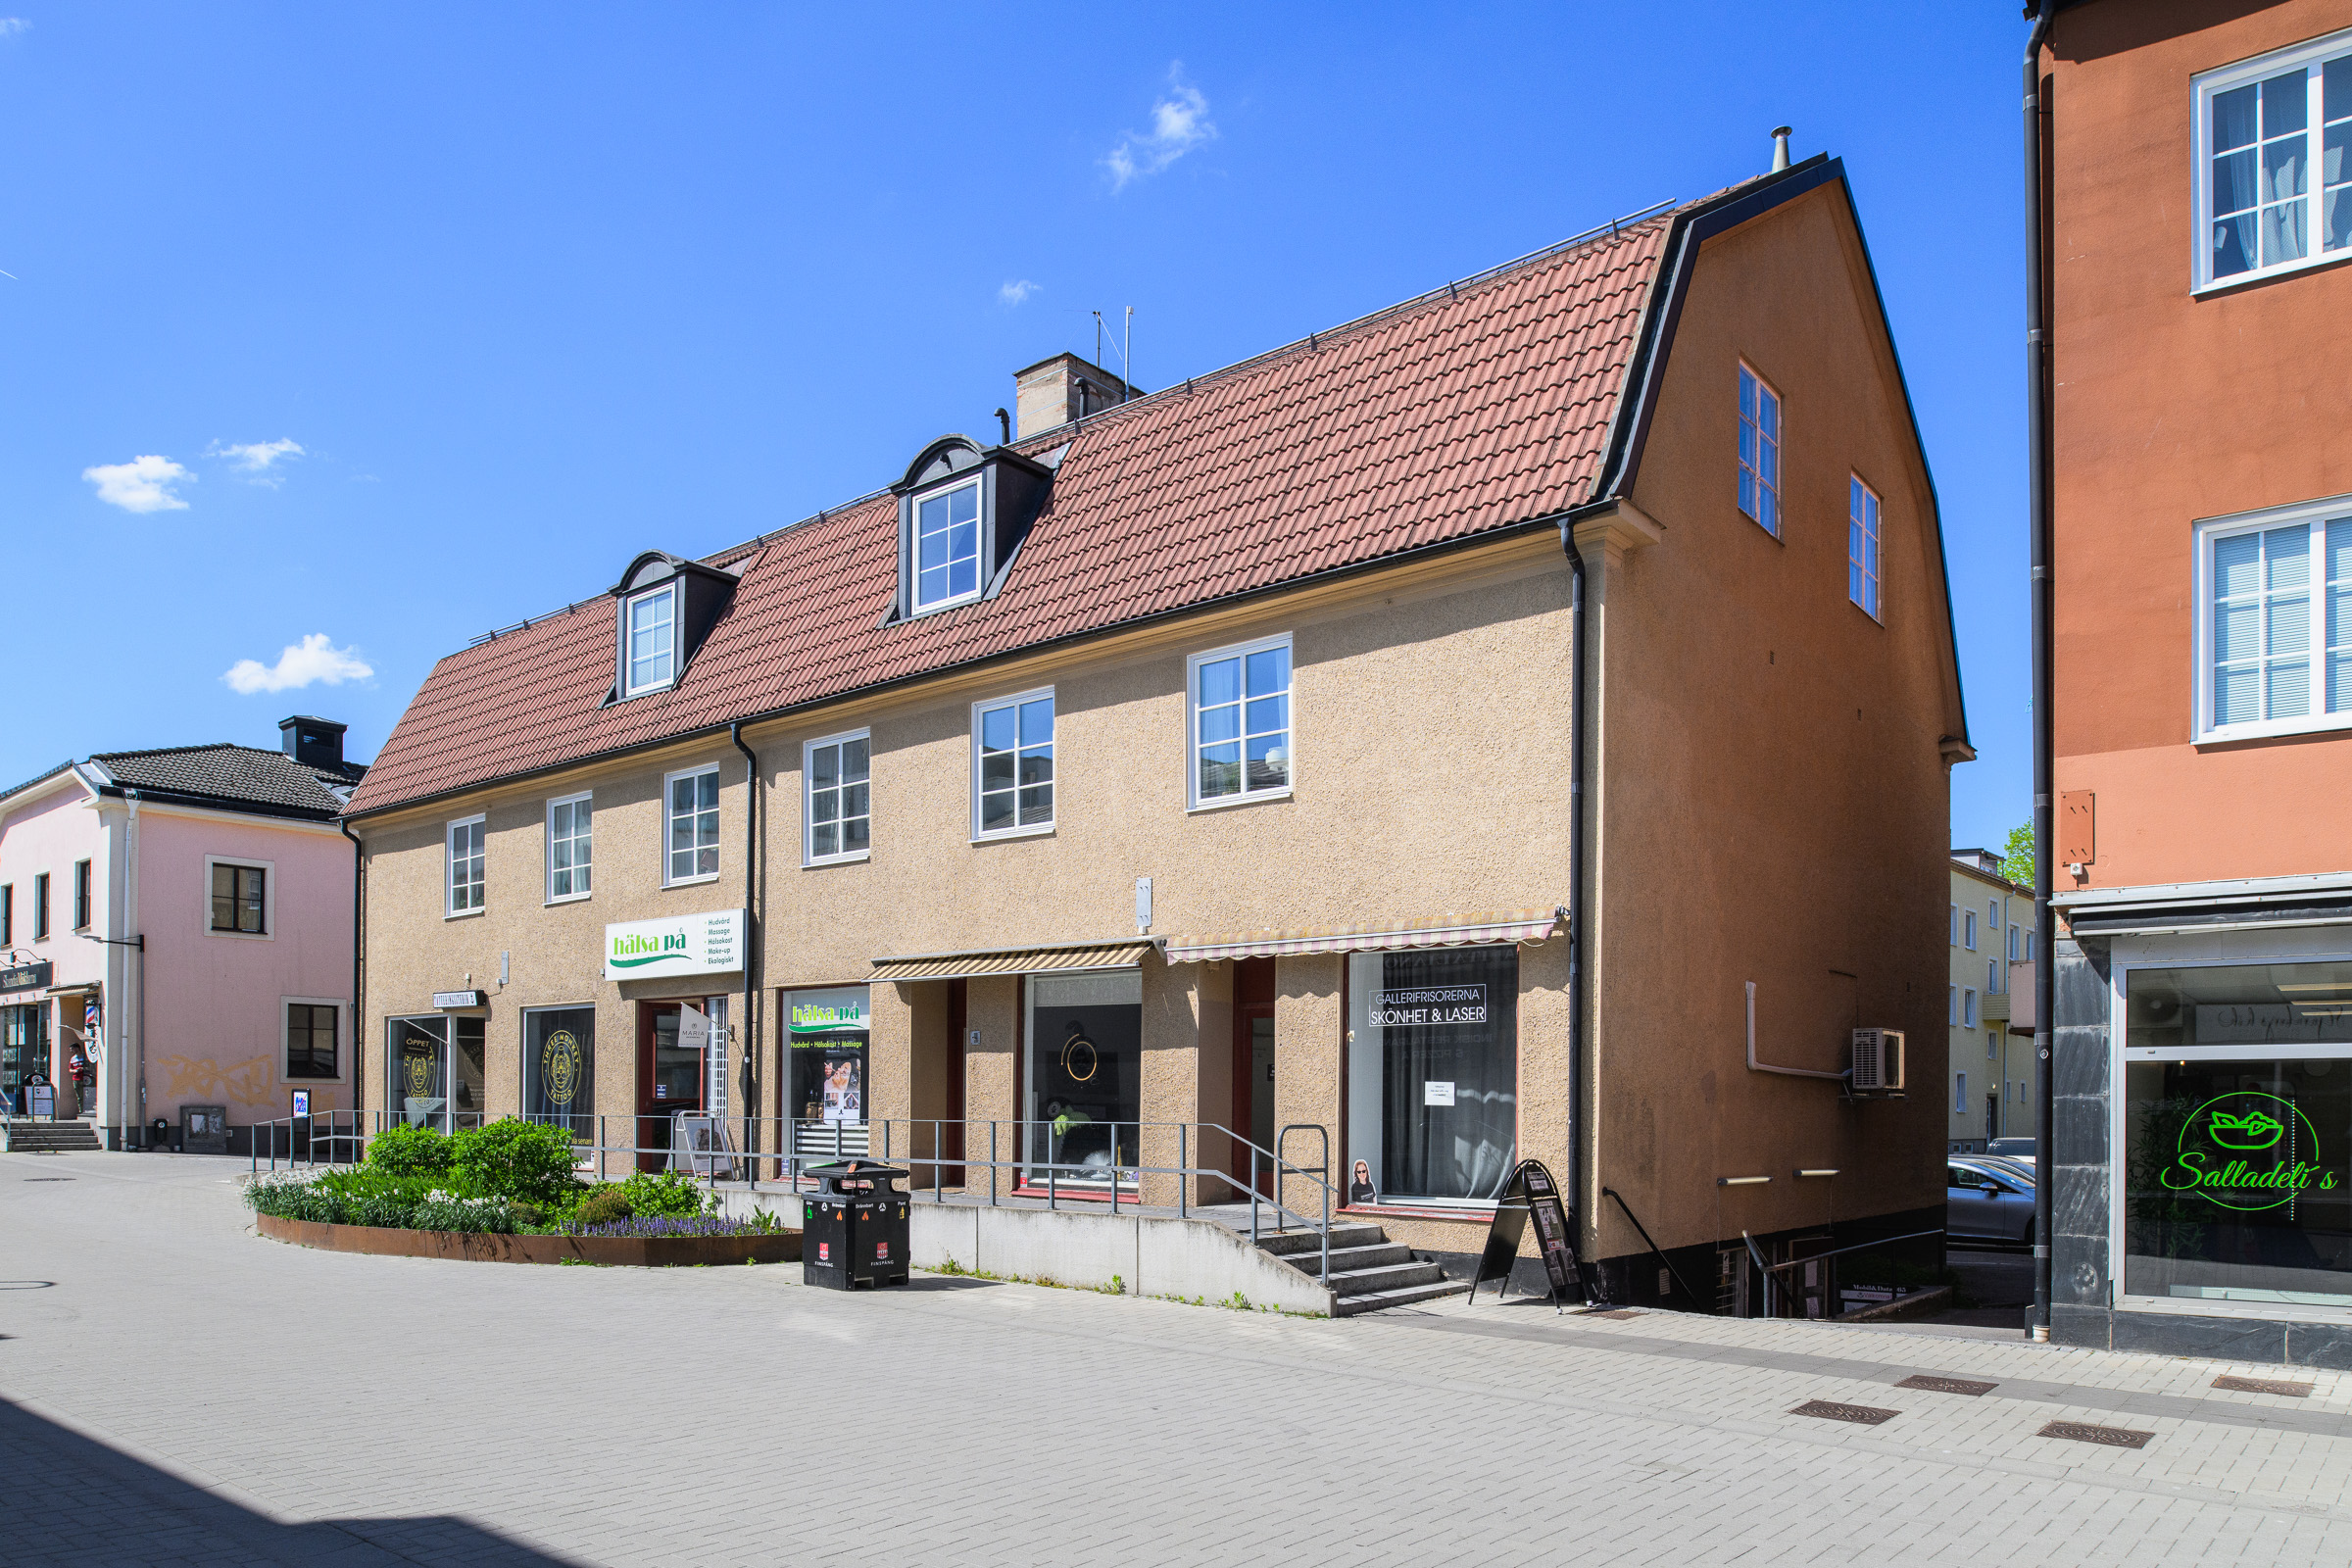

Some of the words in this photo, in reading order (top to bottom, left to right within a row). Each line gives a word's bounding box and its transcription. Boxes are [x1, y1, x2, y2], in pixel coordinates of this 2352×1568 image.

[708, 917, 730, 926] Hudvård
[613, 934, 659, 955] hälsa
[663, 927, 686, 951] på
[708, 937, 733, 946] Hälsokost
[708, 956, 734, 965] Ekologiskt
[1375, 989, 1480, 1004] GALLERIFRISORERNA
[792, 1004, 834, 1022] hälsa
[839, 1001, 859, 1020] på
[1371, 1007, 1428, 1025] SKÖNHET
[1432, 1008, 1442, 1022] &
[1446, 1006, 1485, 1022] LASER
[406, 1037, 430, 1047] ÖPPET
[814, 1040, 837, 1049] Hälsokost
[544, 1036, 558, 1064] THREE
[560, 1034, 579, 1062] MONKEY
[551, 1089, 572, 1101] TATTOO
